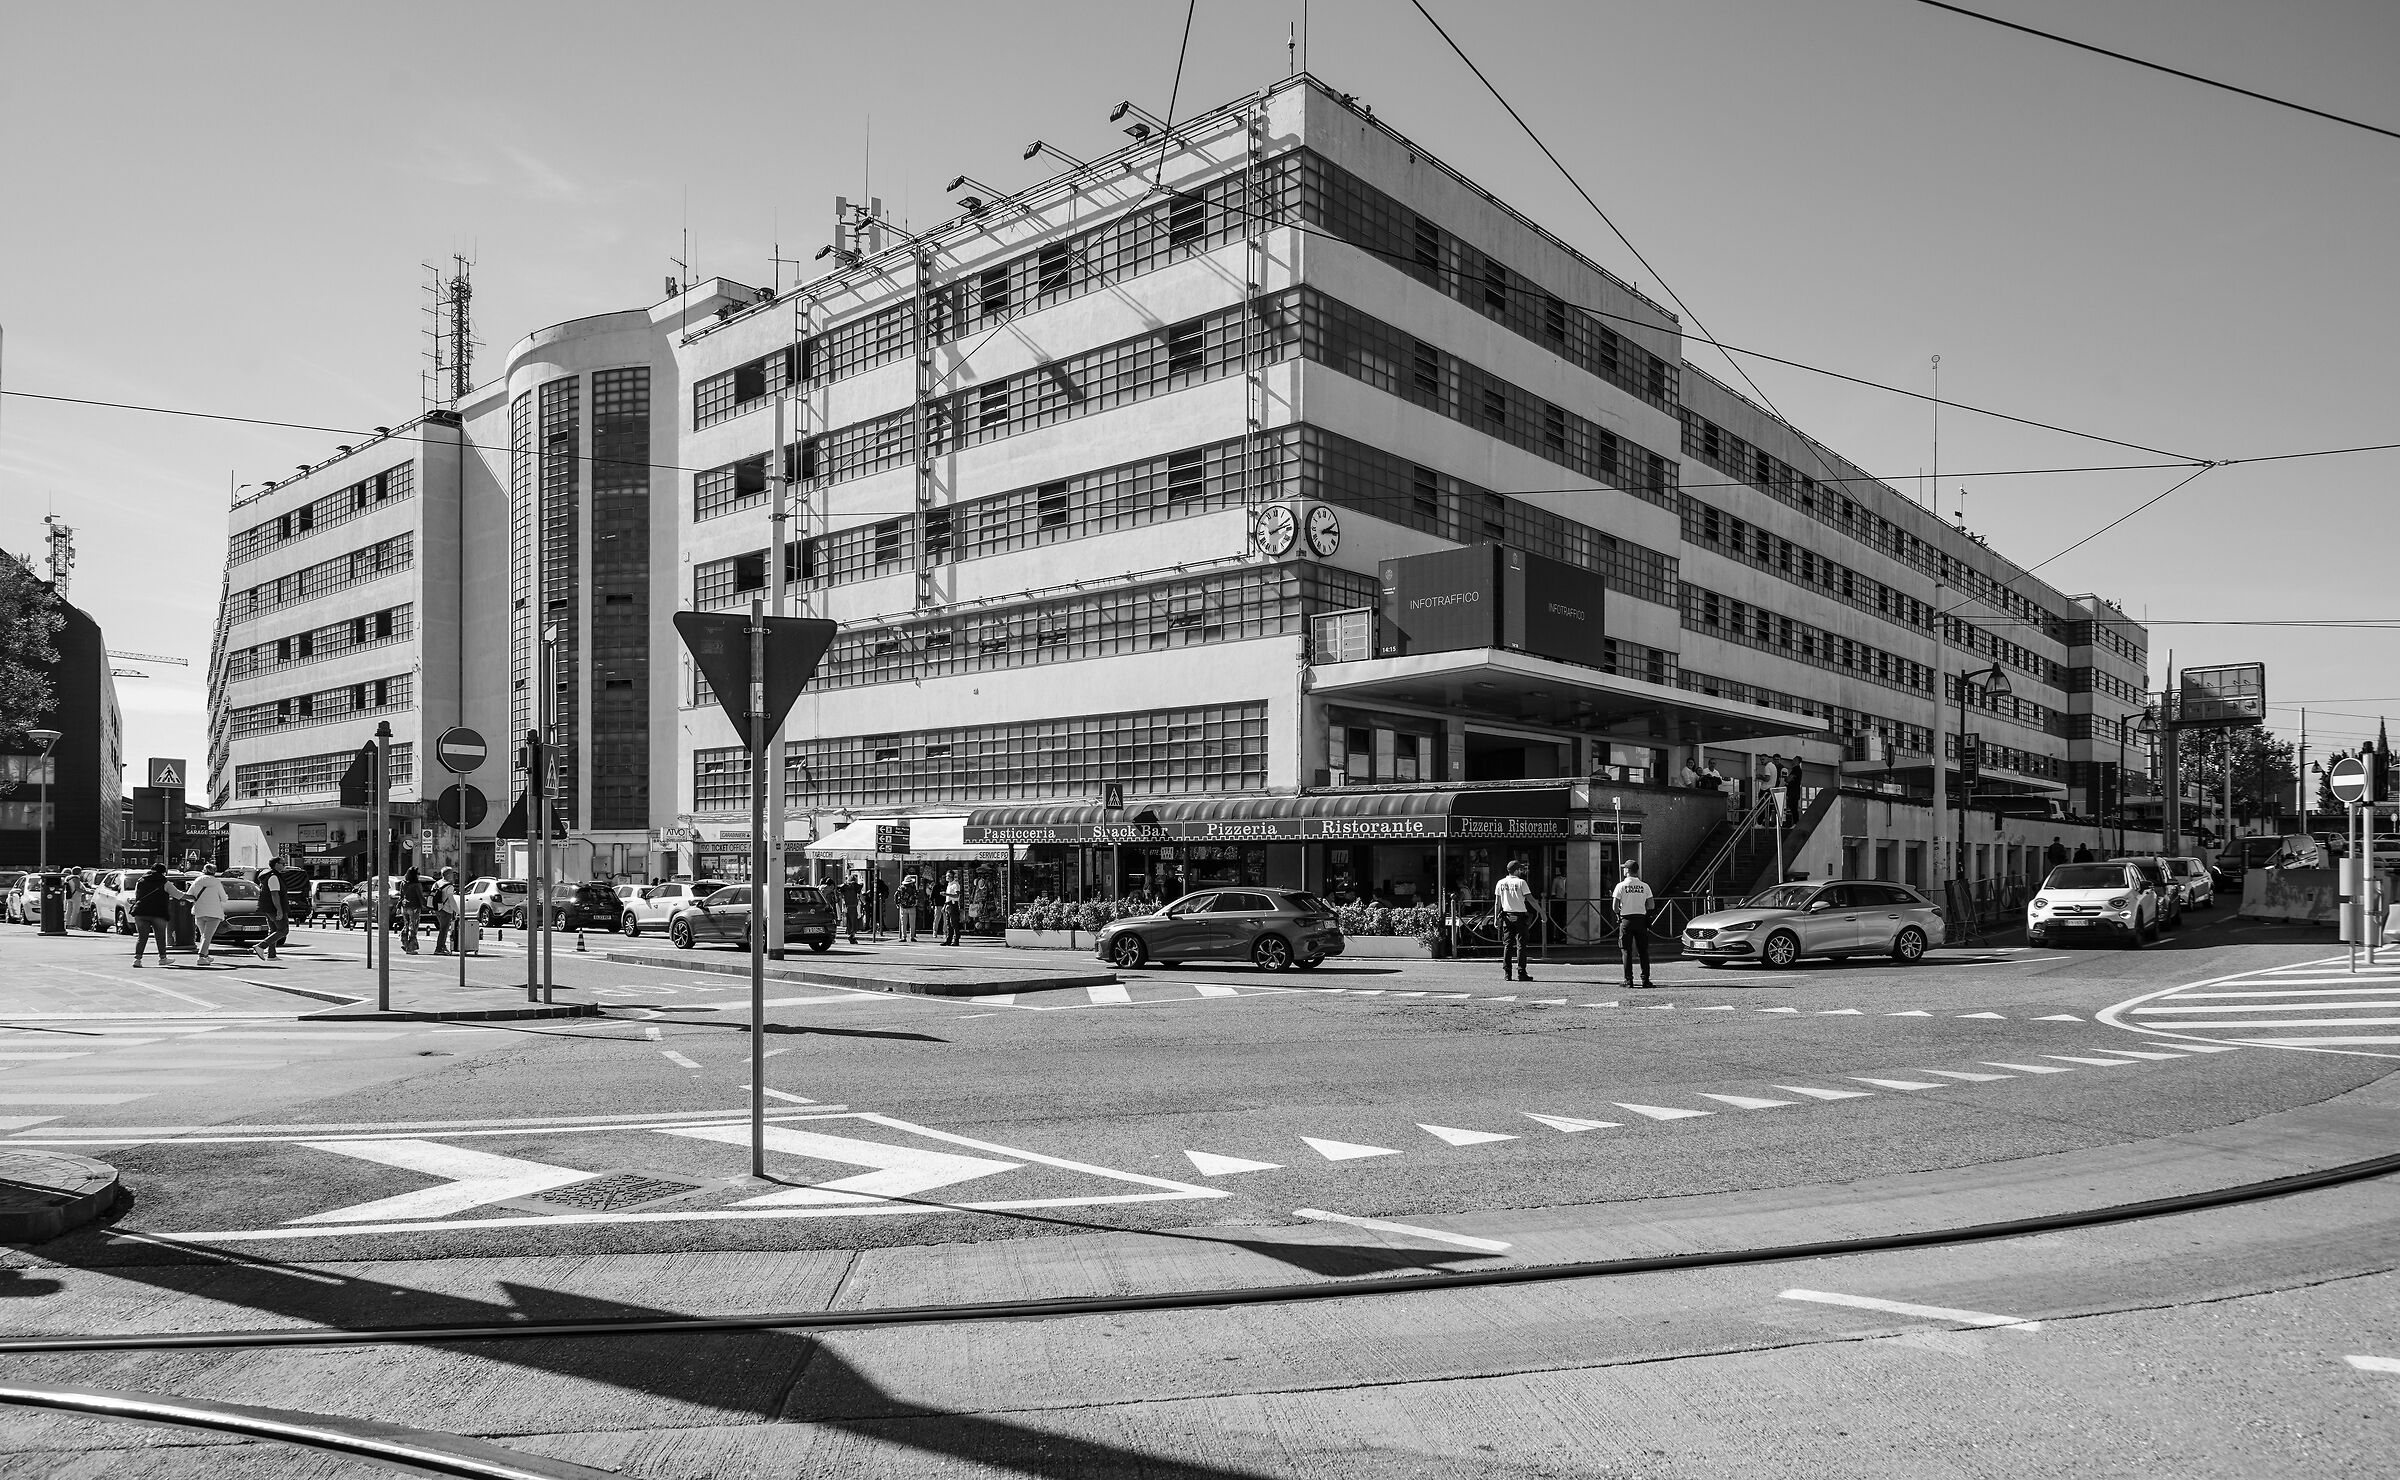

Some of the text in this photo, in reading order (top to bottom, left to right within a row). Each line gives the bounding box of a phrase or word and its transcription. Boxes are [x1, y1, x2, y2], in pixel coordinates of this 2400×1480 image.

[1409, 591, 1480, 610] INFOTRAFFICO
[1549, 602, 1585, 621] INFOTRAFFICO
[1382, 645, 1397, 653] 14:15
[666, 828, 686, 836] ATVO
[1093, 824, 1169, 838] Snack Bar
[1206, 821, 1278, 836] Pizzeria
[1321, 819, 1424, 834] Ristorante
[1461, 817, 1558, 833] Pizzeria Ristorante
[983, 827, 1057, 839] Pasticceria
[729, 843, 747, 851] OFFICE
[979, 851, 1000, 859] SERVICE
